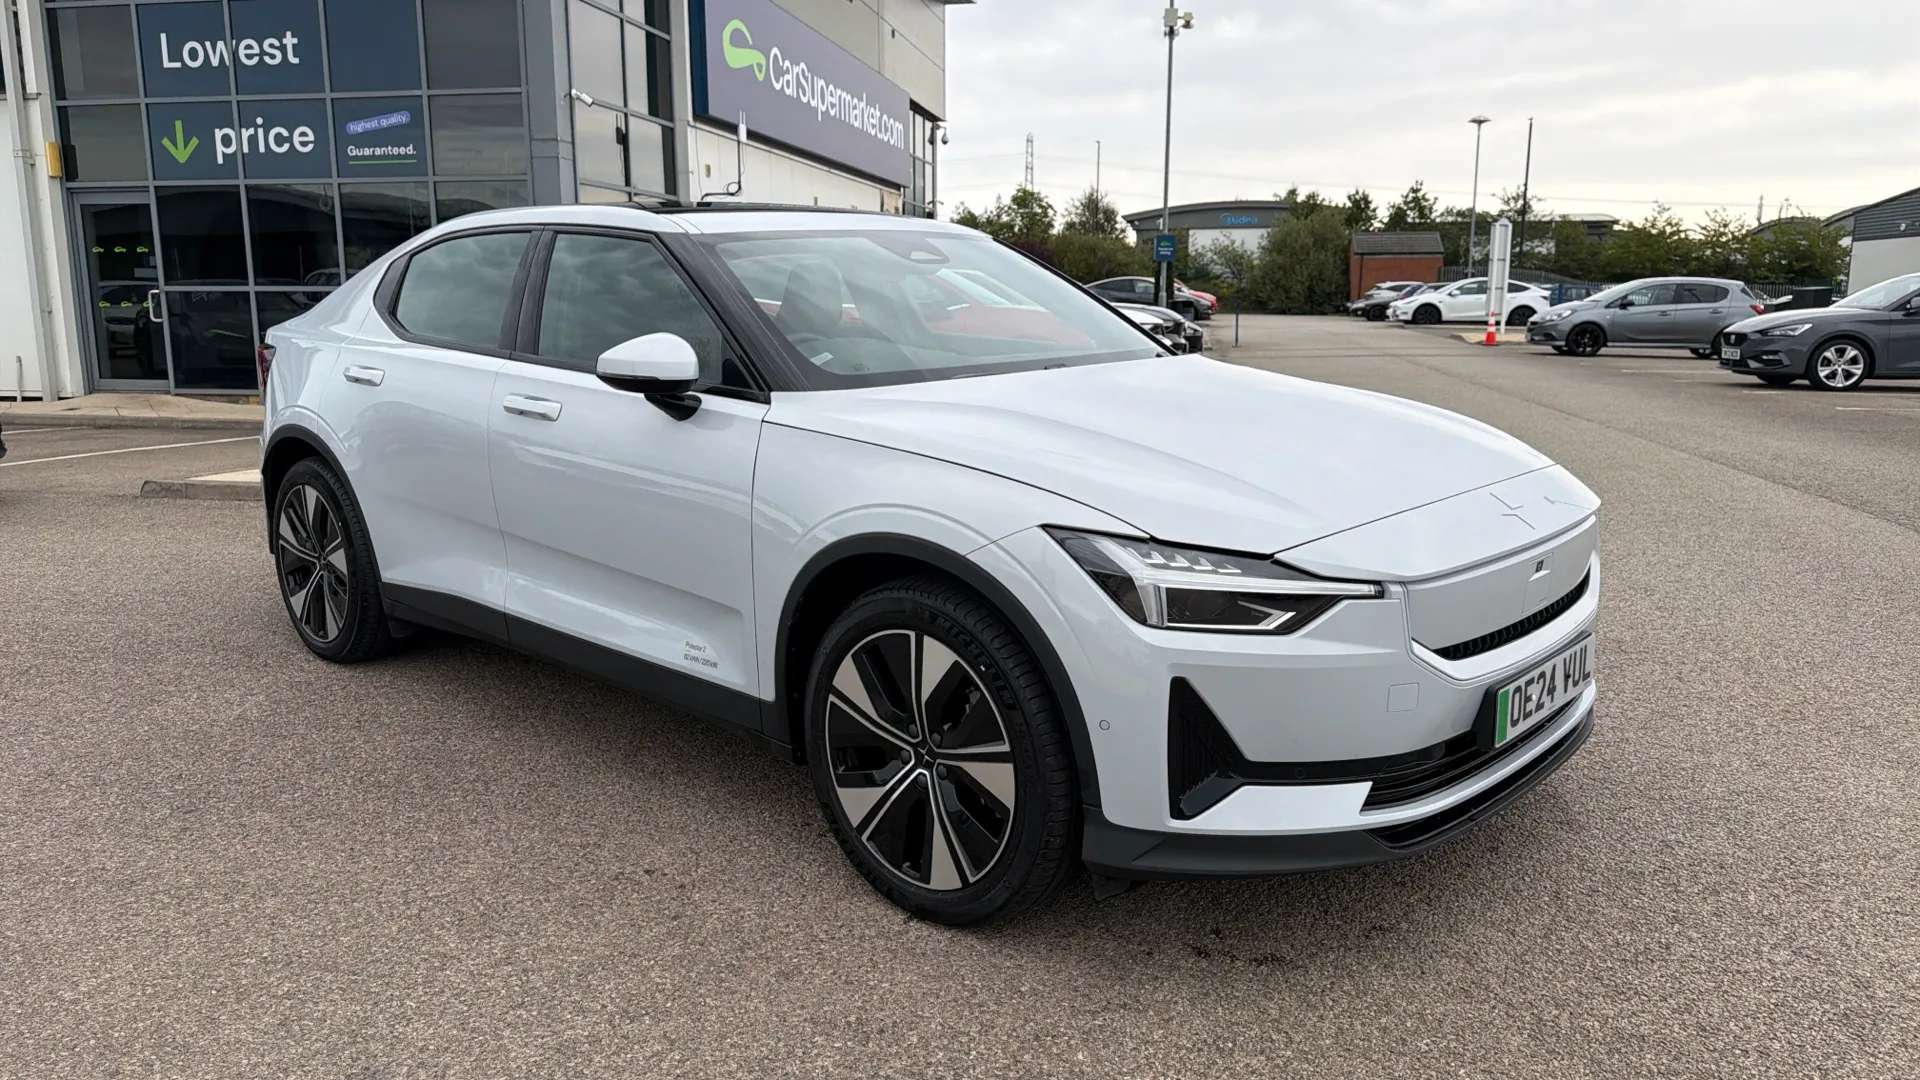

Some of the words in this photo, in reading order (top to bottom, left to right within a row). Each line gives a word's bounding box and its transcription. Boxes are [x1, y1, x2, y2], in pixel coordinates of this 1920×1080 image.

[160, 31, 300, 68] Lowest
[769, 46, 904, 150] CarSupermarket.com
[214, 116, 315, 164] price
[350, 119, 379, 133] highest
[347, 143, 417, 156] Guaranteed.
[1510, 664, 1557, 728] OE24
[1563, 644, 1591, 694] VUL
